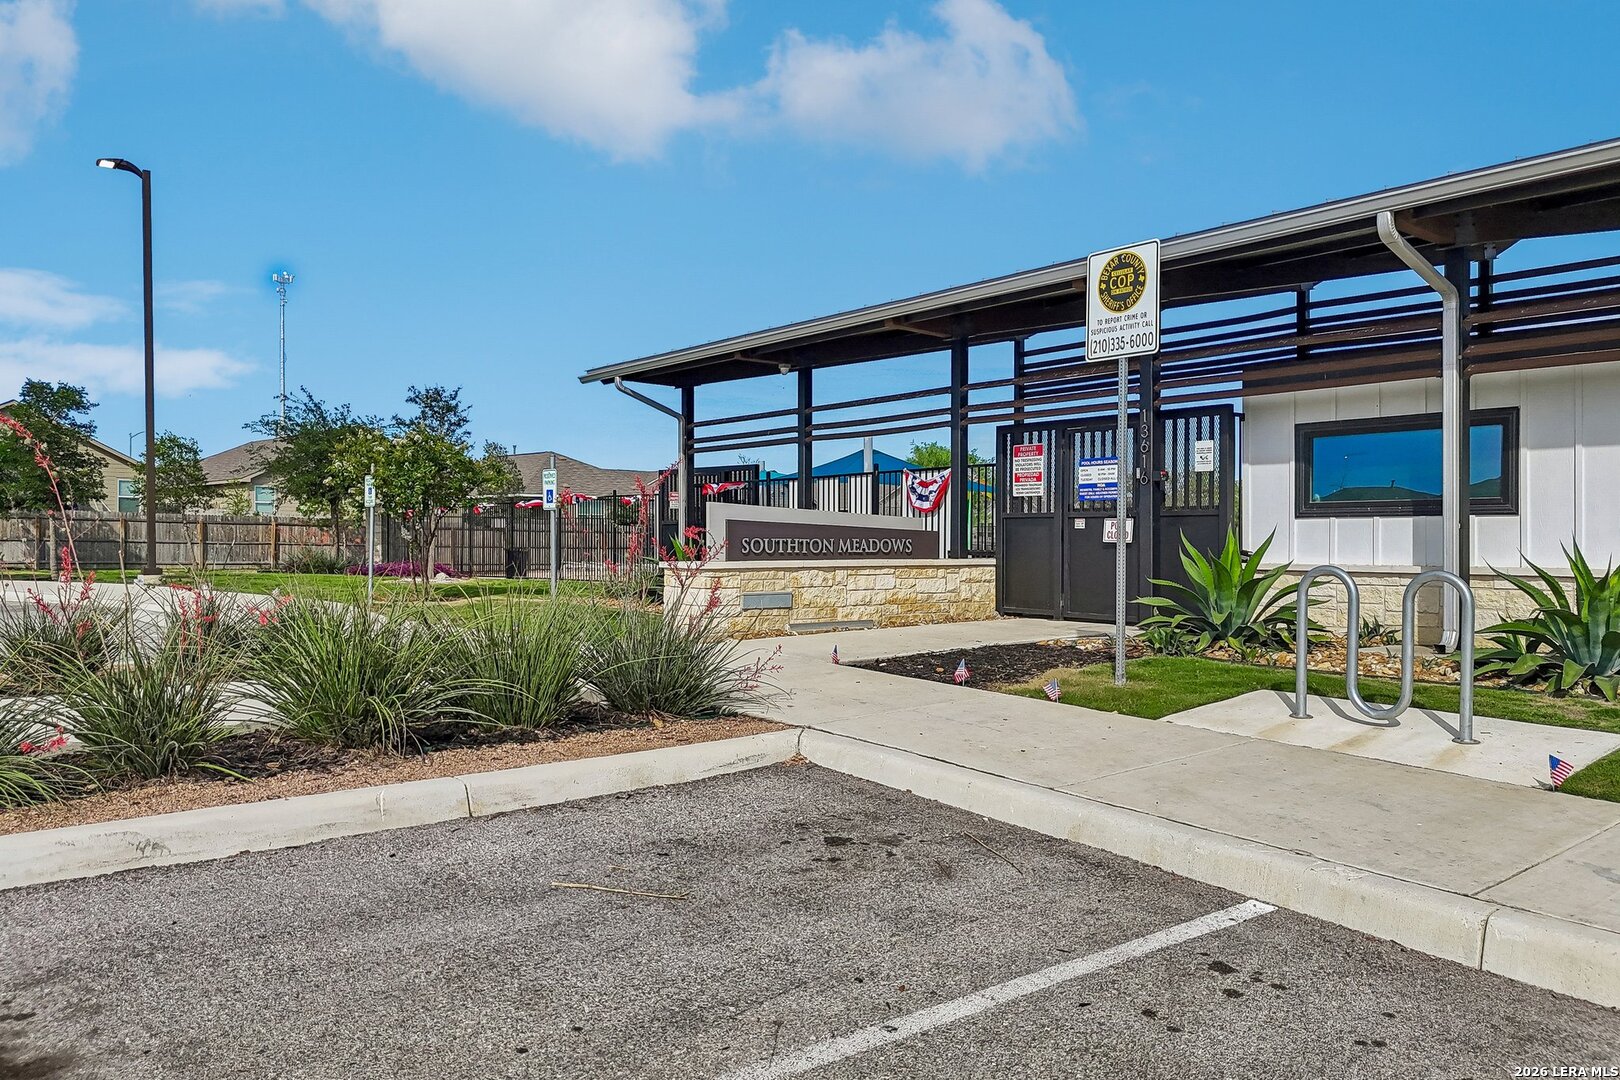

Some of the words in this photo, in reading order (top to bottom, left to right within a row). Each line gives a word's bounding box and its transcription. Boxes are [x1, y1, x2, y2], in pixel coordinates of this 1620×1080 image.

[1101, 257, 1120, 281] BEXAR
[1121, 253, 1145, 274] COUNTY
[1110, 273, 1134, 290] COP
[1101, 291, 1125, 311] SHERIFF'S
[1126, 285, 1144, 308] OFFICE
[1091, 326, 1118, 336] SUSPICIOUS
[1120, 322, 1140, 331] ACTIVITY
[1142, 320, 1154, 328] CALL
[1105, 316, 1122, 325] REPORT
[1124, 313, 1138, 322] CRIME
[1091, 332, 1154, 357] (210)335-6000
[741, 537, 834, 555] SOUTHTON
[838, 538, 913, 555] MEADOWS
